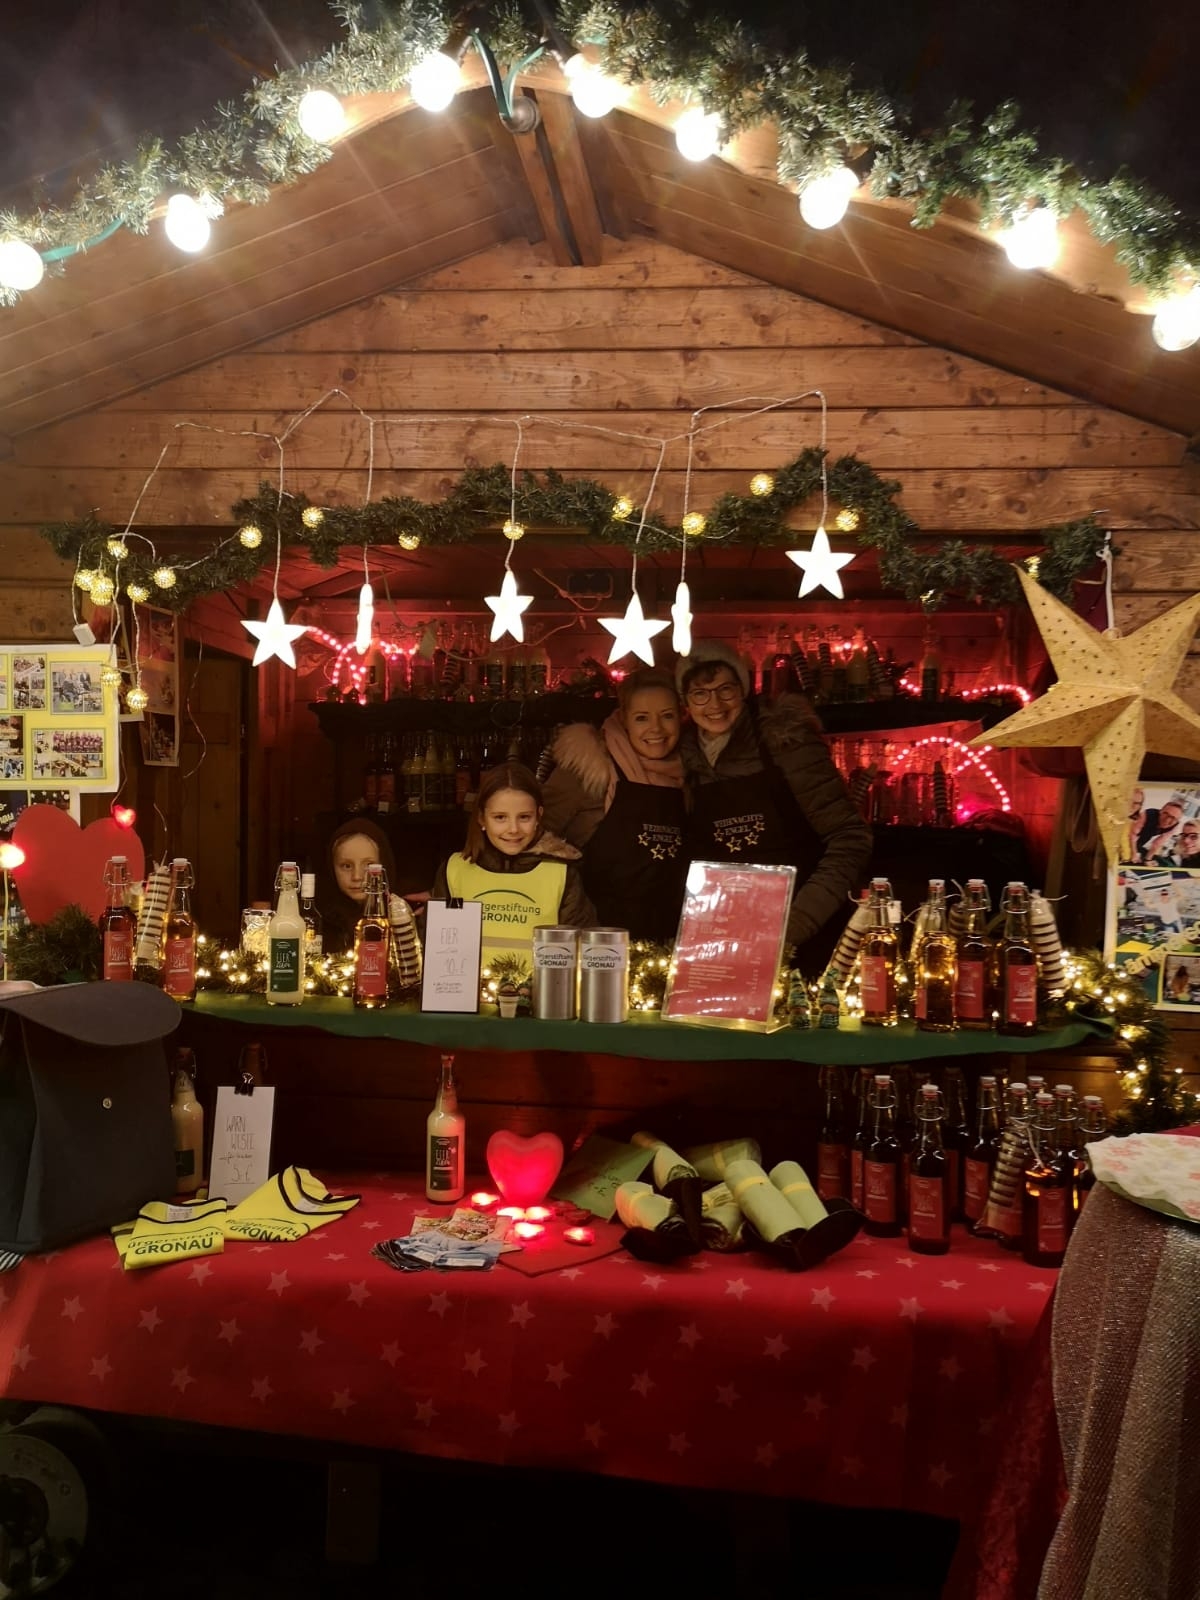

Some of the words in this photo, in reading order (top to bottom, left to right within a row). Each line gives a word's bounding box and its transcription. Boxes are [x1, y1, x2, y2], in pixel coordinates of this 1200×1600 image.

[539, 959, 568, 968] GRONAU
[587, 961, 616, 969] GRONAU
[135, 1238, 214, 1255] GRONAU
